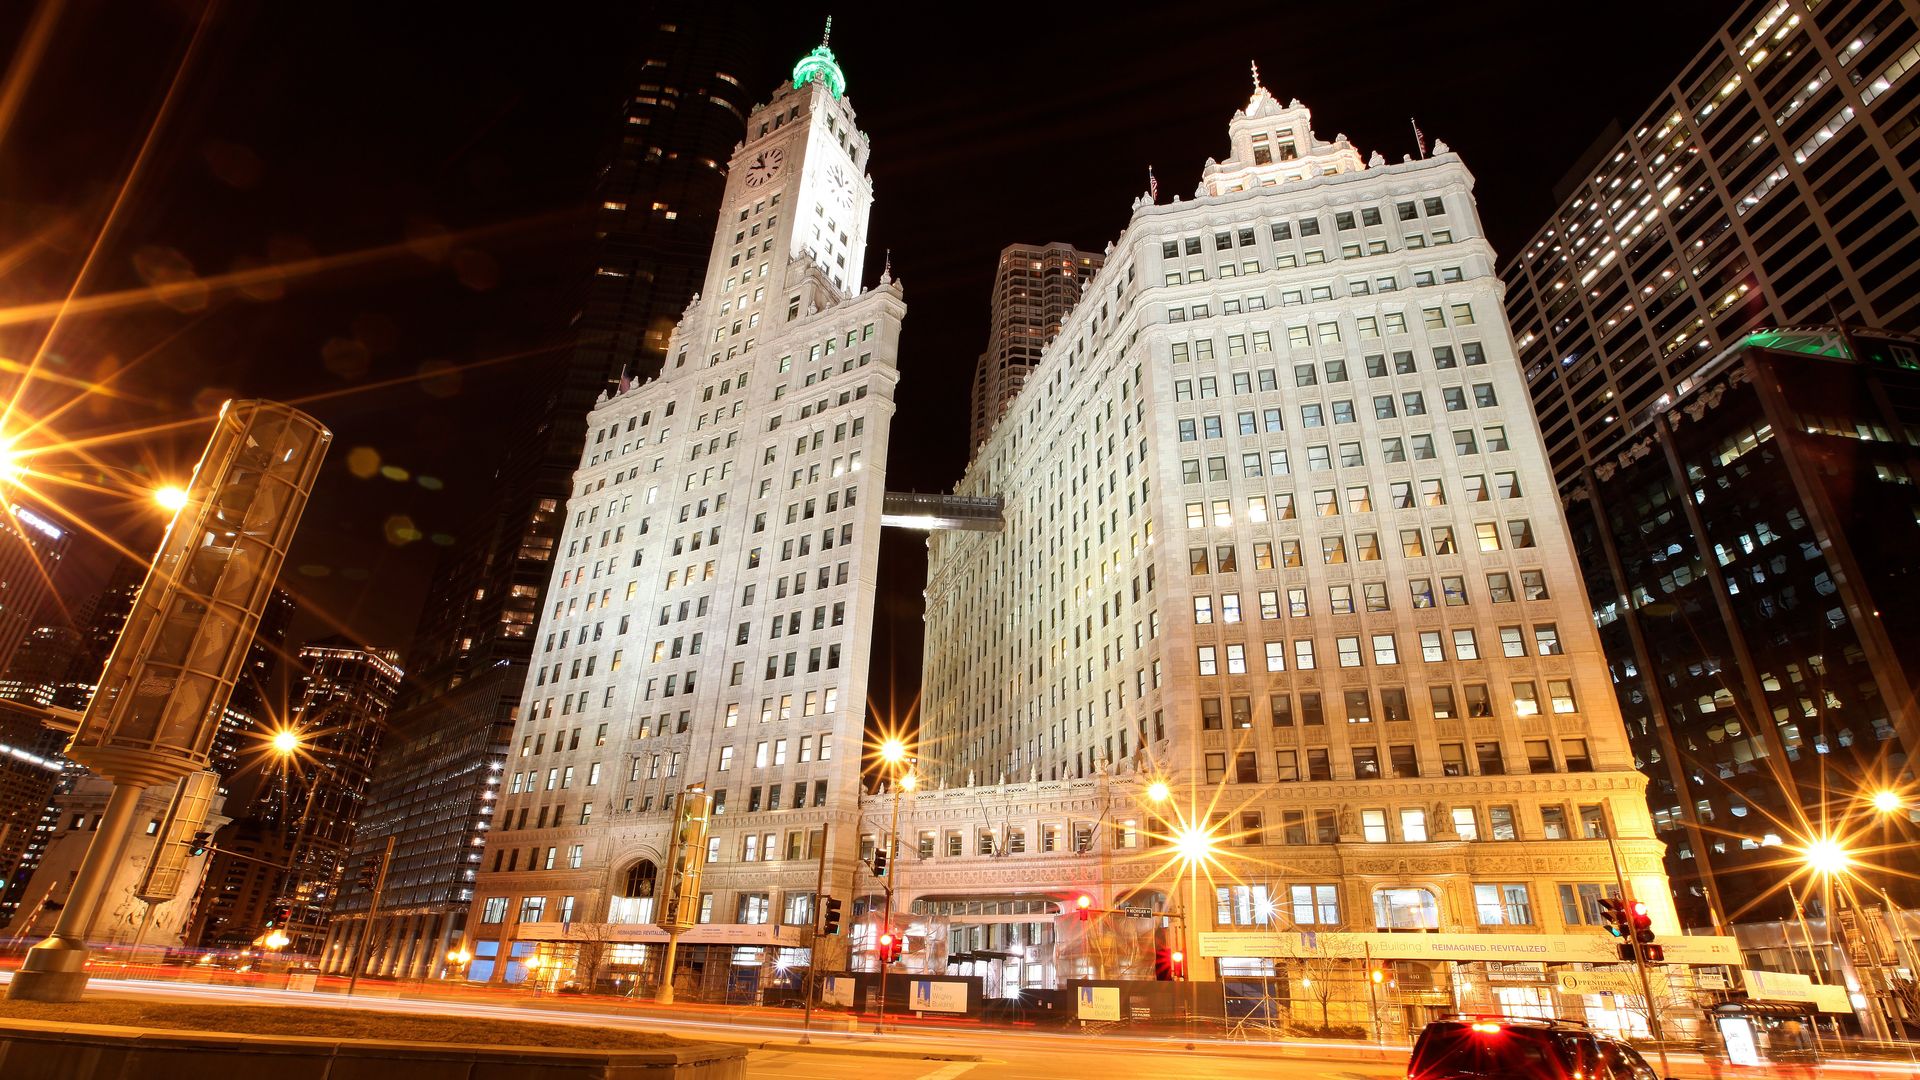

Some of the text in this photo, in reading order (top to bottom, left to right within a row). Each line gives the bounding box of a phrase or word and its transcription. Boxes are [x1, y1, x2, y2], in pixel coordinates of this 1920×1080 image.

[1380, 941, 1422, 953] Building
[1432, 943, 1489, 952] REIMAGINED.
[1490, 944, 1550, 953] REVITALIZED.
